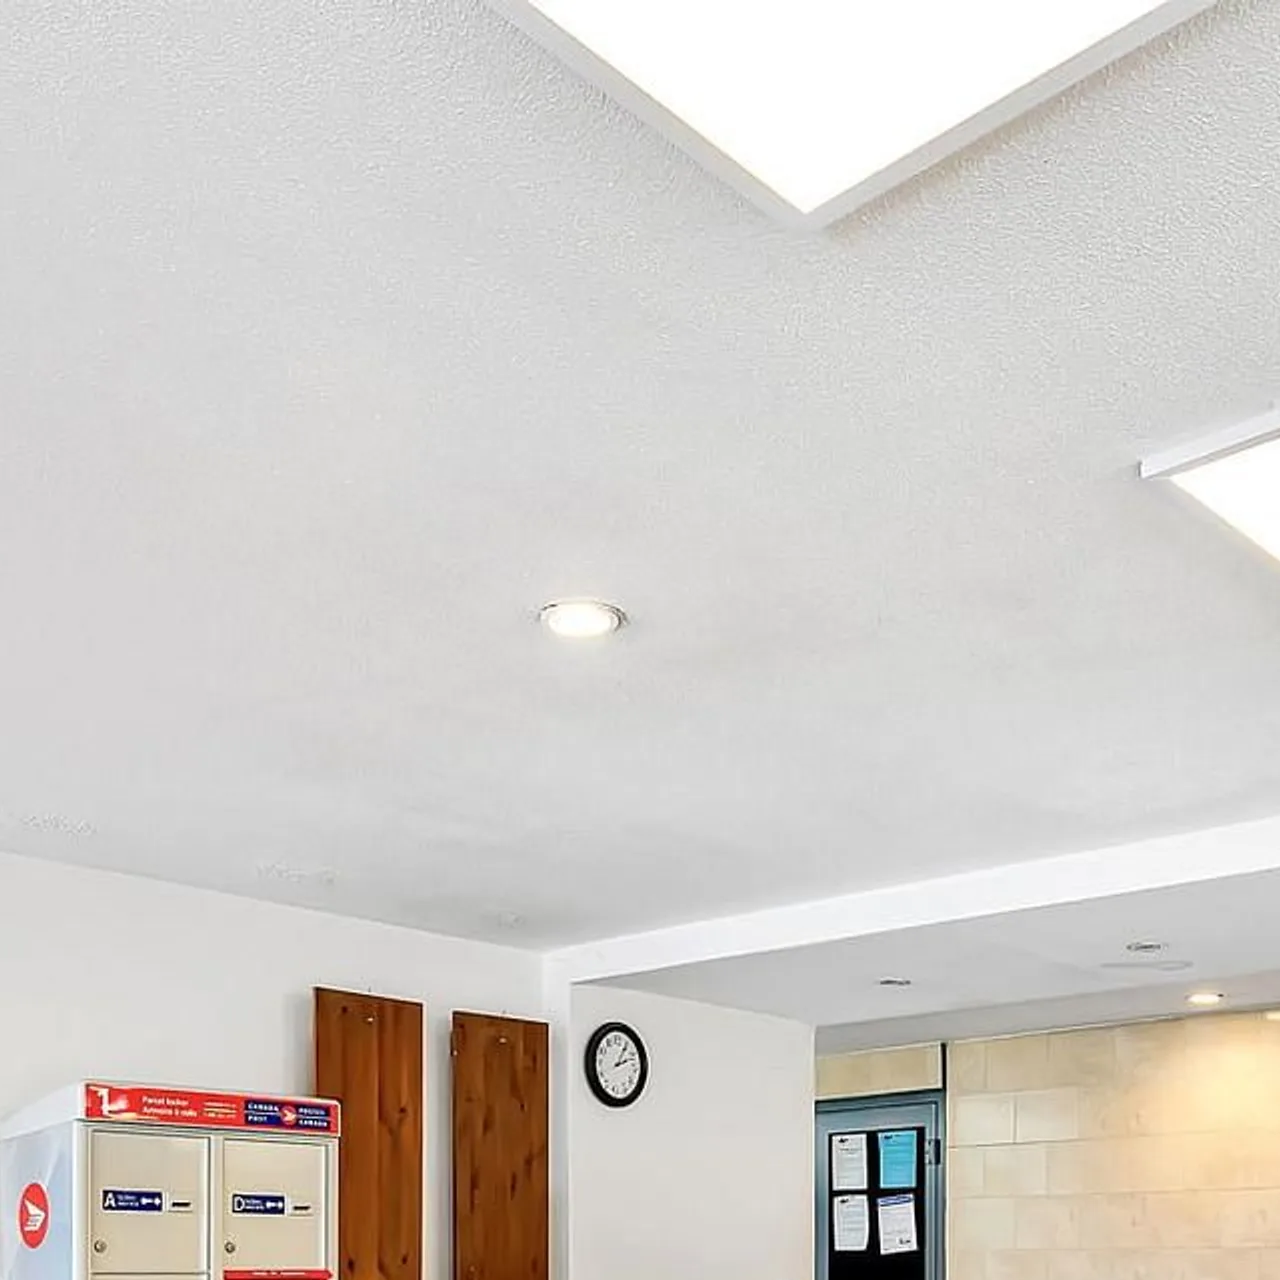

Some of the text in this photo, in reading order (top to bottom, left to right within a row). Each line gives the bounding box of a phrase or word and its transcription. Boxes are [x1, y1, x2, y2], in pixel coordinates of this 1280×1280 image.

[247, 1102, 280, 1112] CANADA
[247, 1114, 268, 1122] POST
[298, 1118, 328, 1127] CANADA
[103, 1192, 116, 1207] A
[234, 1196, 245, 1211] D
